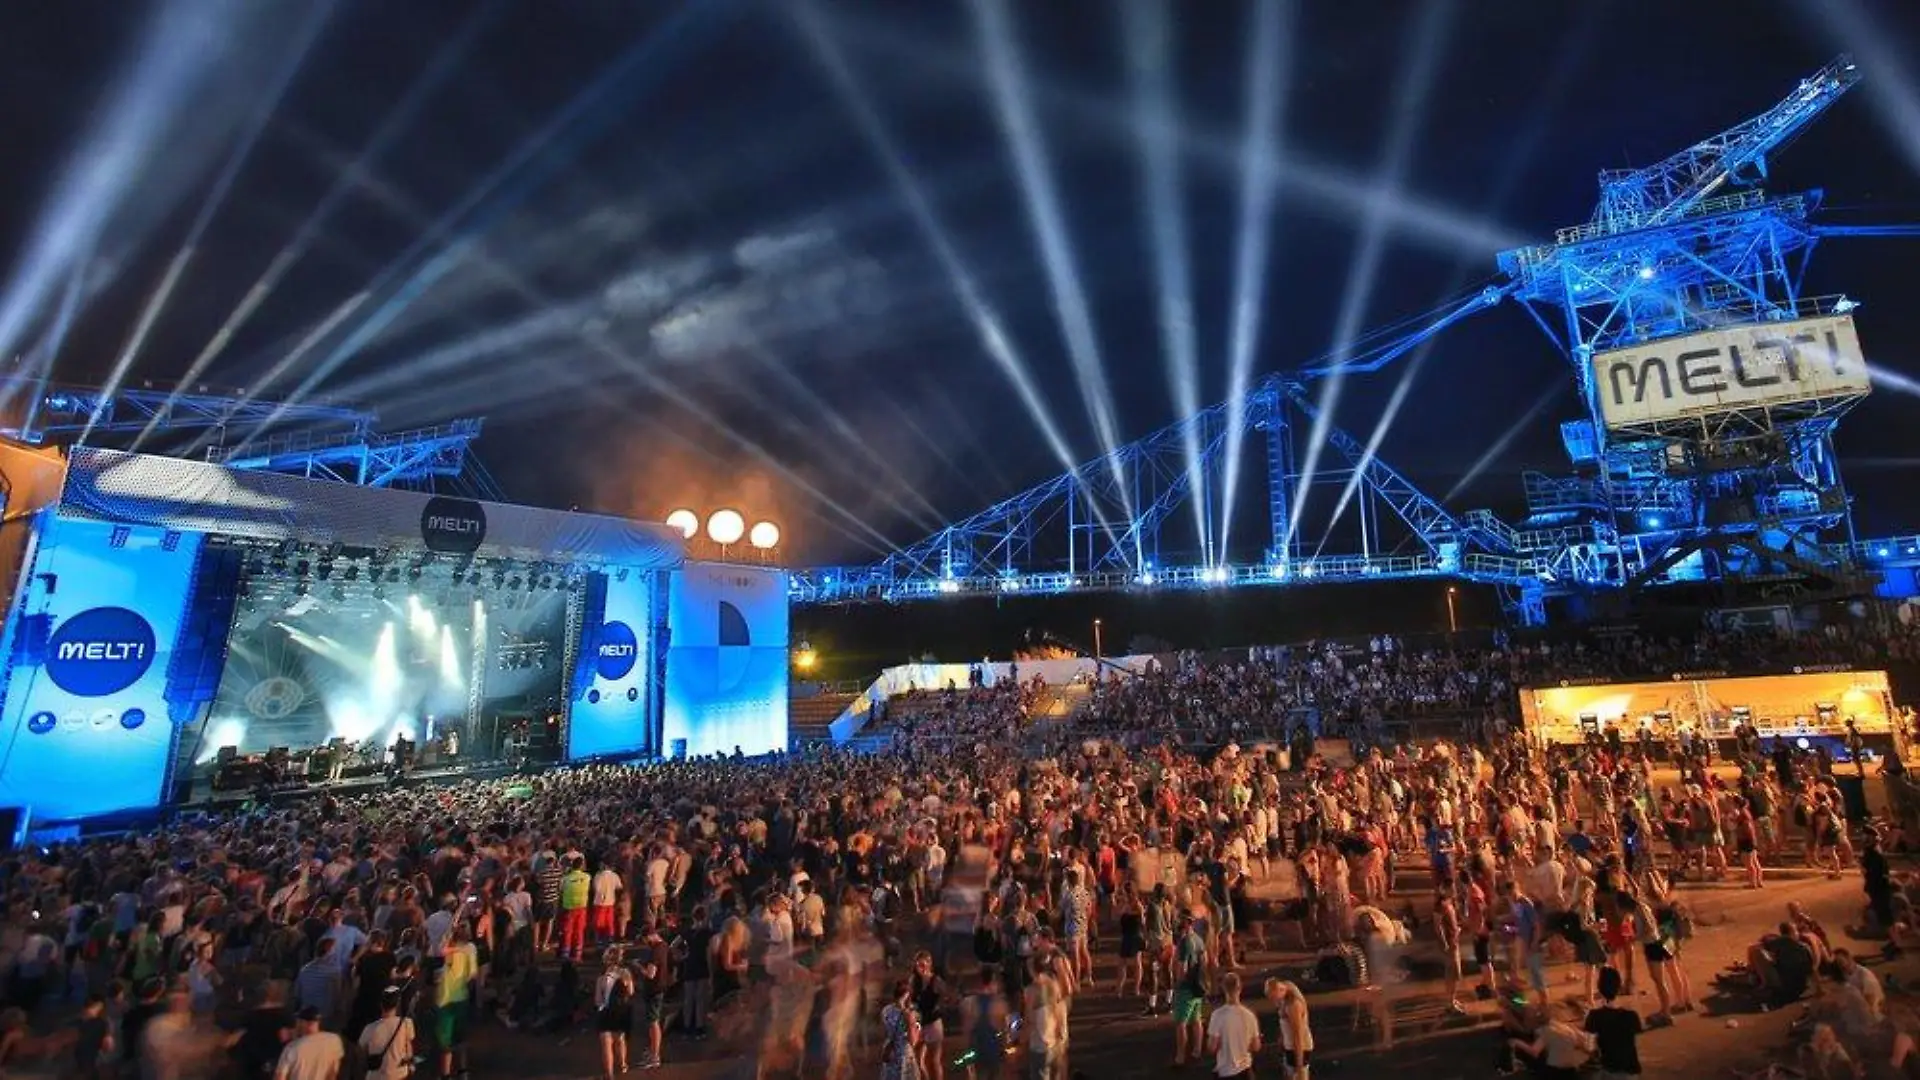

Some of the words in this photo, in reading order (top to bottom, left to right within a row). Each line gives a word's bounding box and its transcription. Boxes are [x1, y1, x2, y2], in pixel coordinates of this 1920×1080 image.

[1608, 327, 1845, 405] MELT!
[428, 516, 479, 533] MELT!
[58, 642, 145, 660] MELT!
